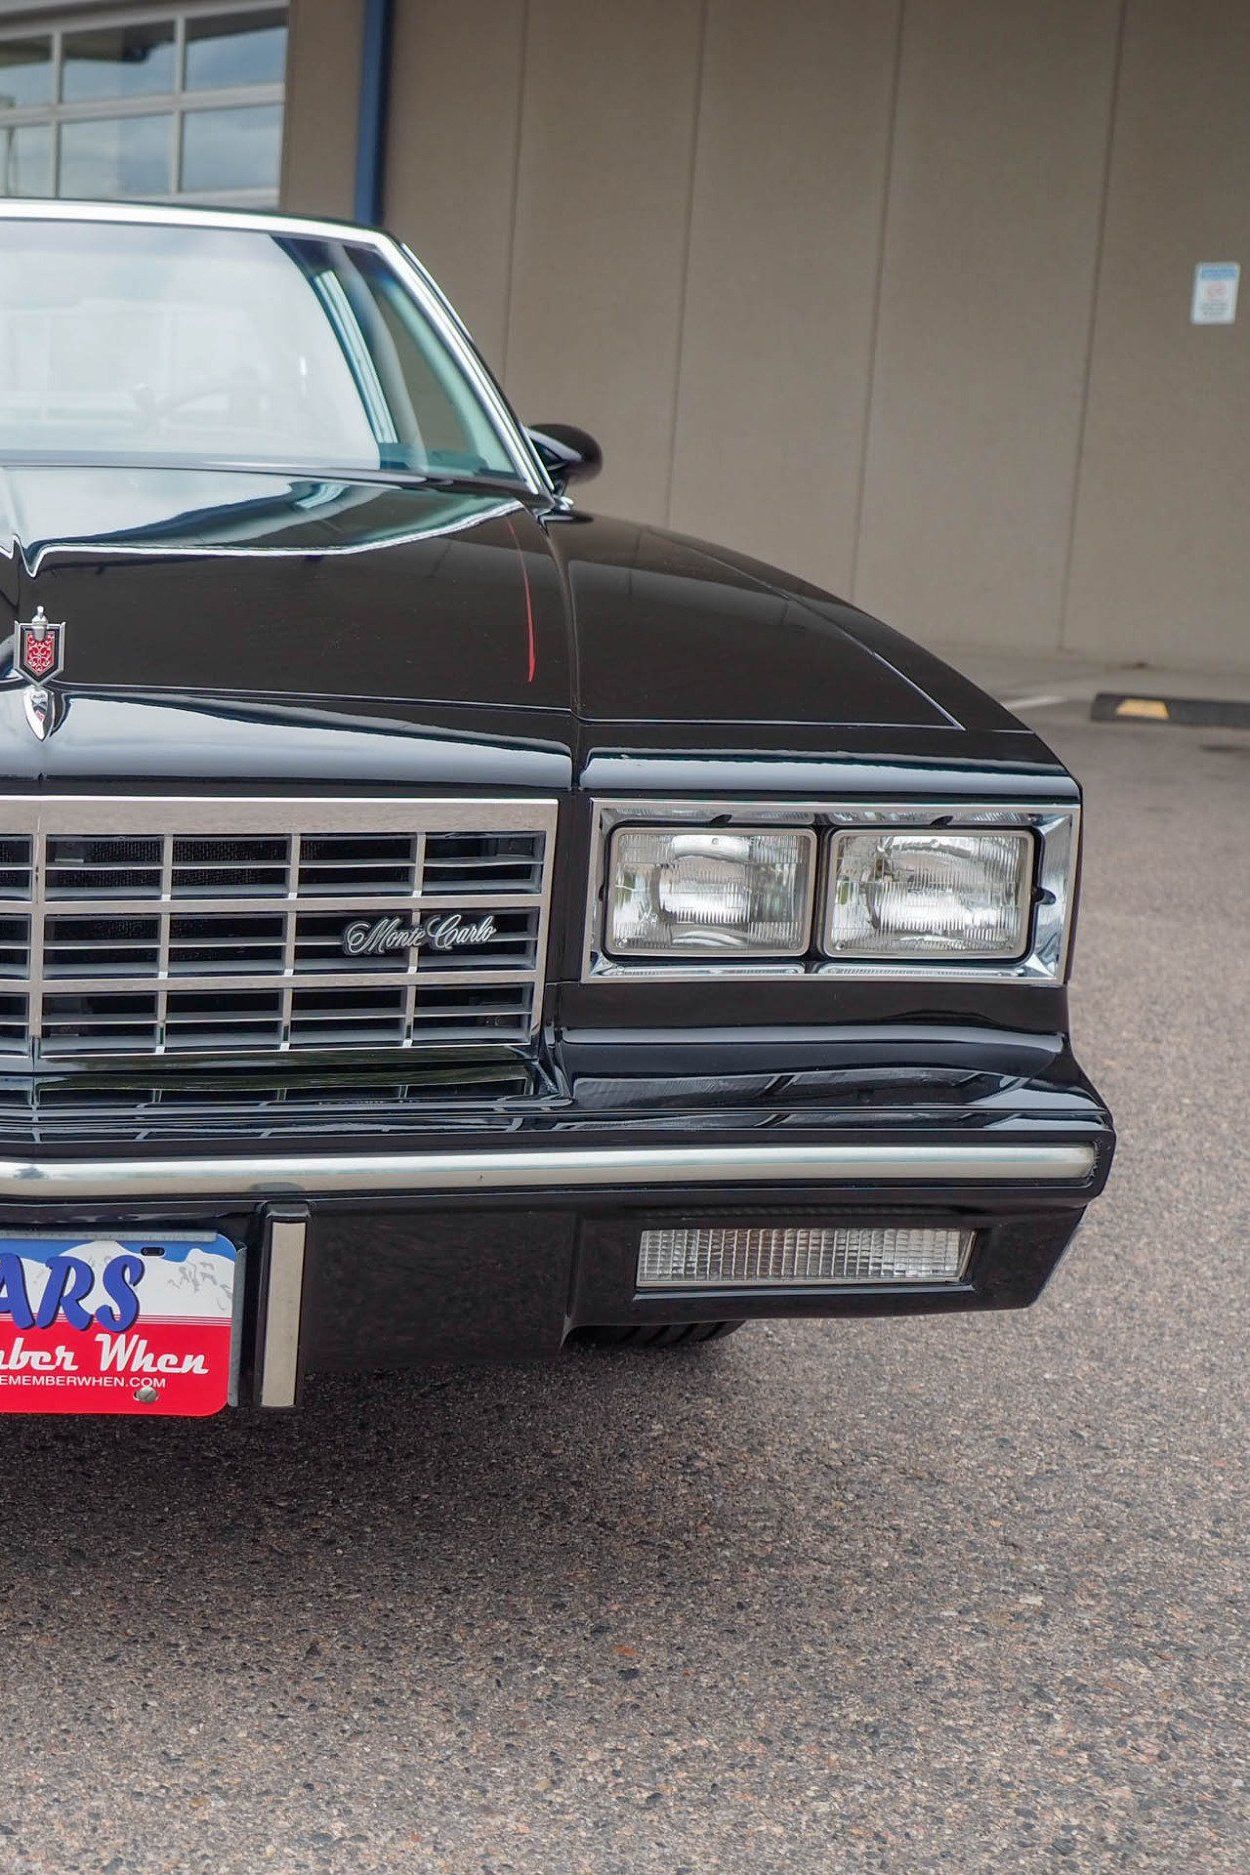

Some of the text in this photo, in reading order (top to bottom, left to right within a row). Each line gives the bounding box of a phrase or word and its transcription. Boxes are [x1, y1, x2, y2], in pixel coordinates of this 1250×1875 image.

[344, 914, 497, 955] Monte Carlo
[95, 1333, 209, 1374] When
